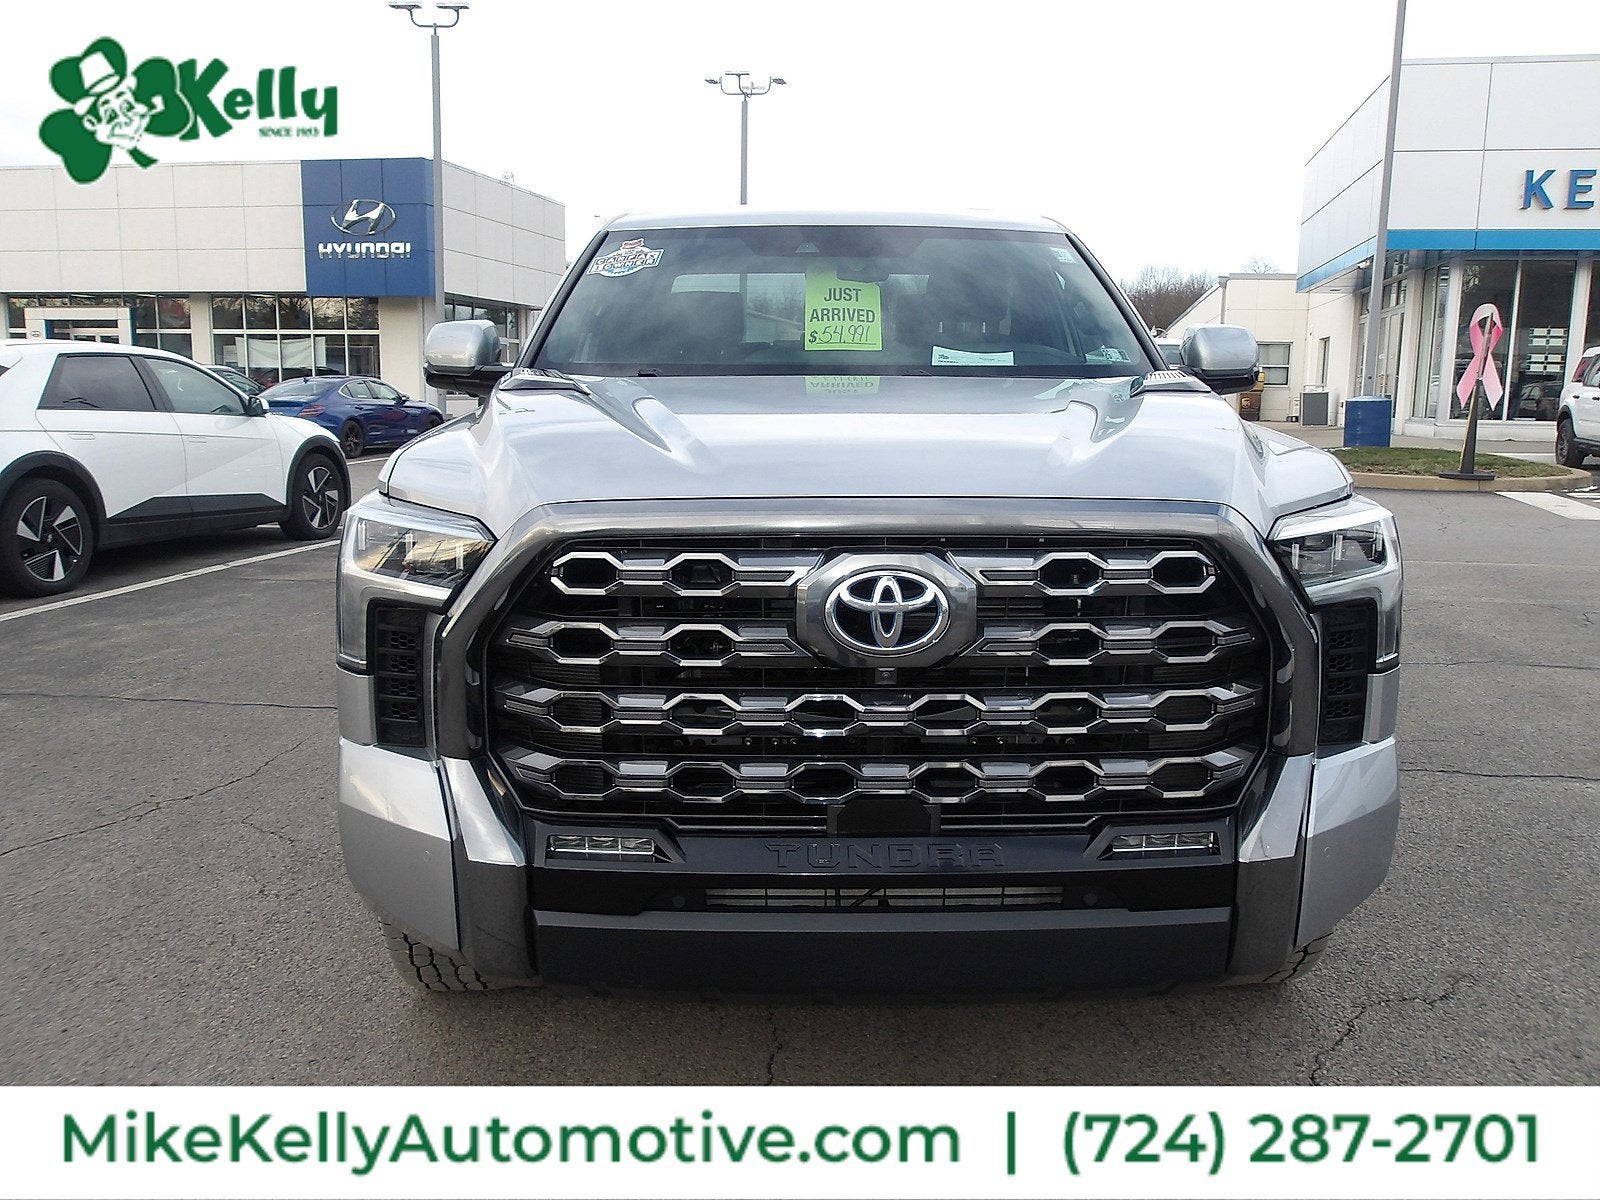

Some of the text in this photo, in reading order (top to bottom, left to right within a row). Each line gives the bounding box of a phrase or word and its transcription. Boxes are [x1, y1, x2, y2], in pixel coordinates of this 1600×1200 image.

[318, 242, 411, 259] HYUNDAI
[823, 287, 862, 303] JUST
[809, 307, 876, 324] ARRIVED
[764, 843, 1006, 869] TUNDRA
